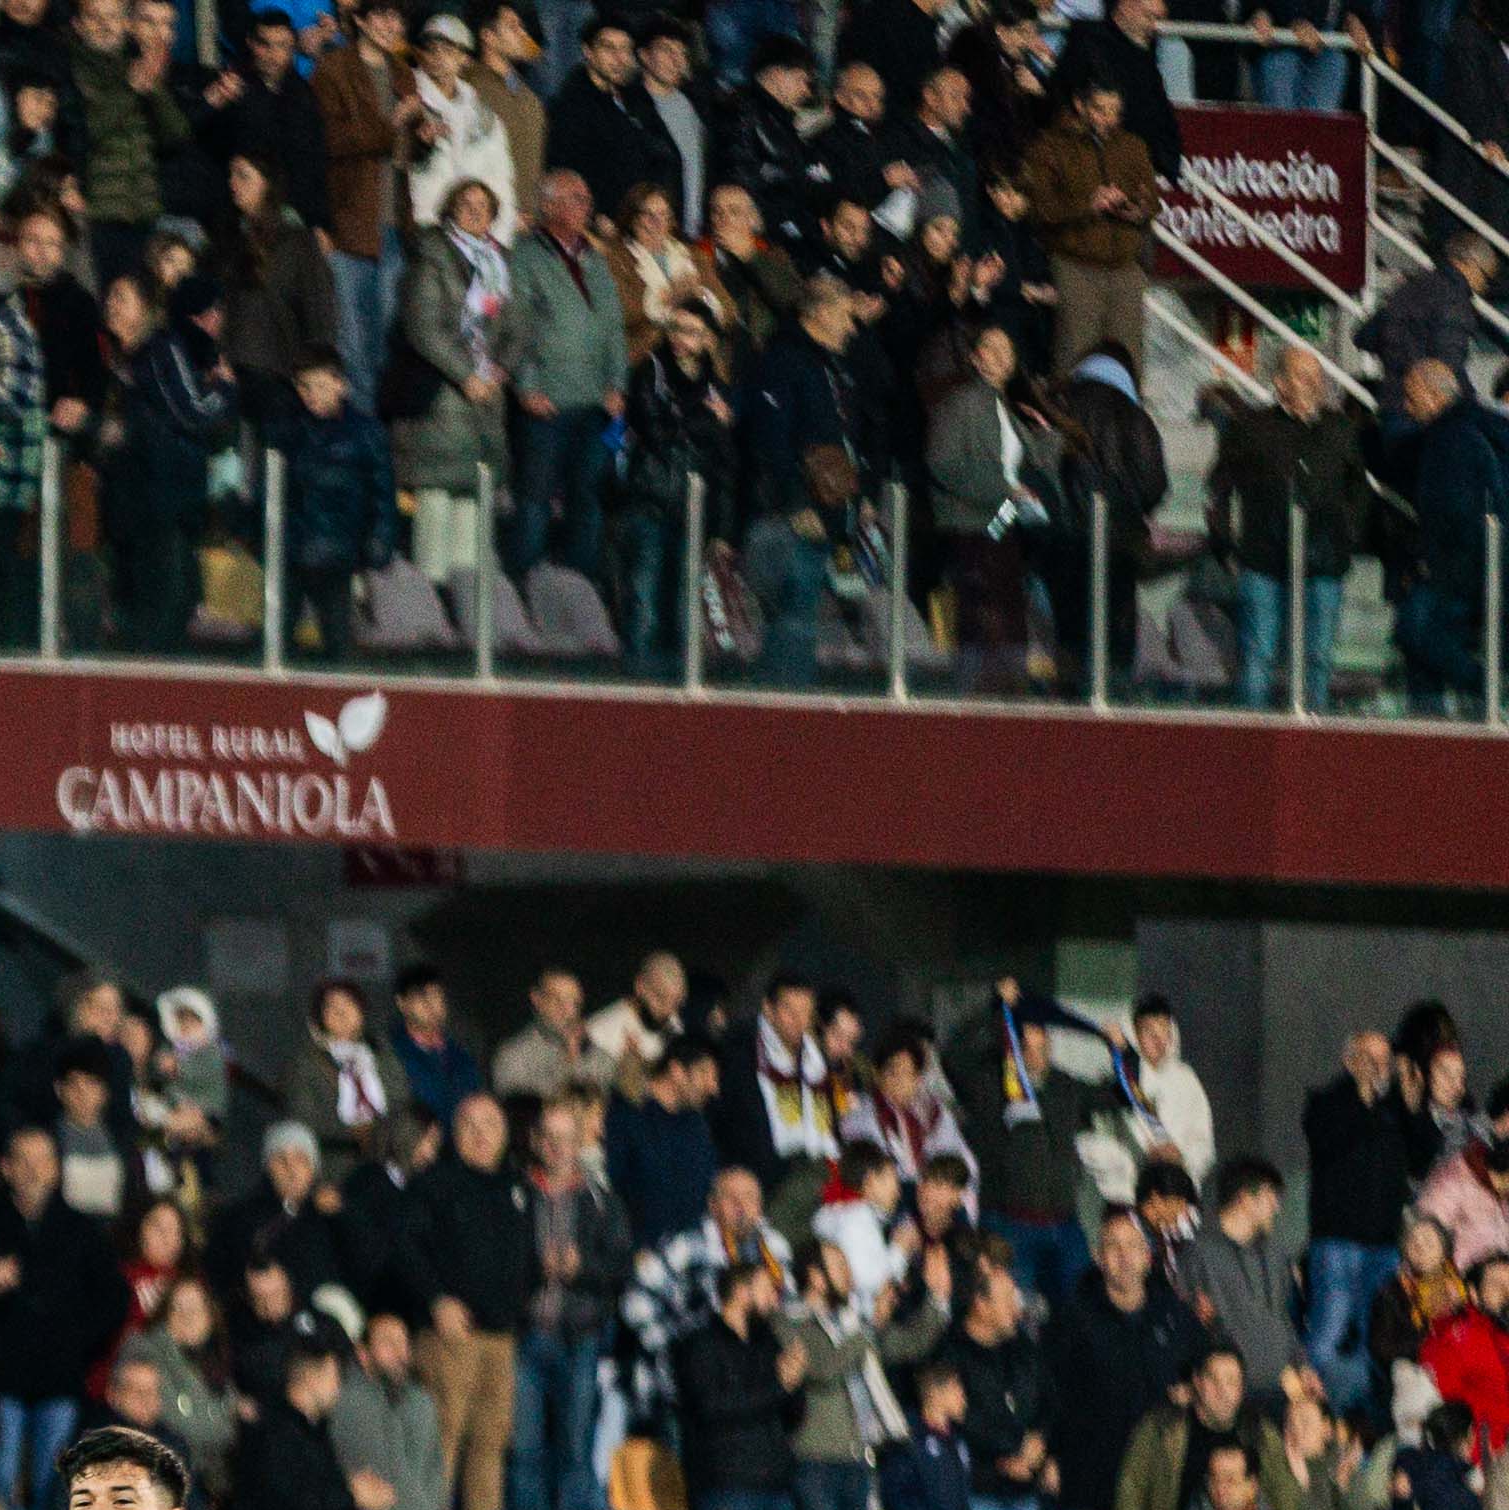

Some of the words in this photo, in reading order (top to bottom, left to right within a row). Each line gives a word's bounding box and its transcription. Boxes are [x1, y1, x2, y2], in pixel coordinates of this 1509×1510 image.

[110, 722, 200, 758] HOTEL
[211, 725, 307, 763] RURAL
[55, 765, 397, 838] CAMPANIOLA
